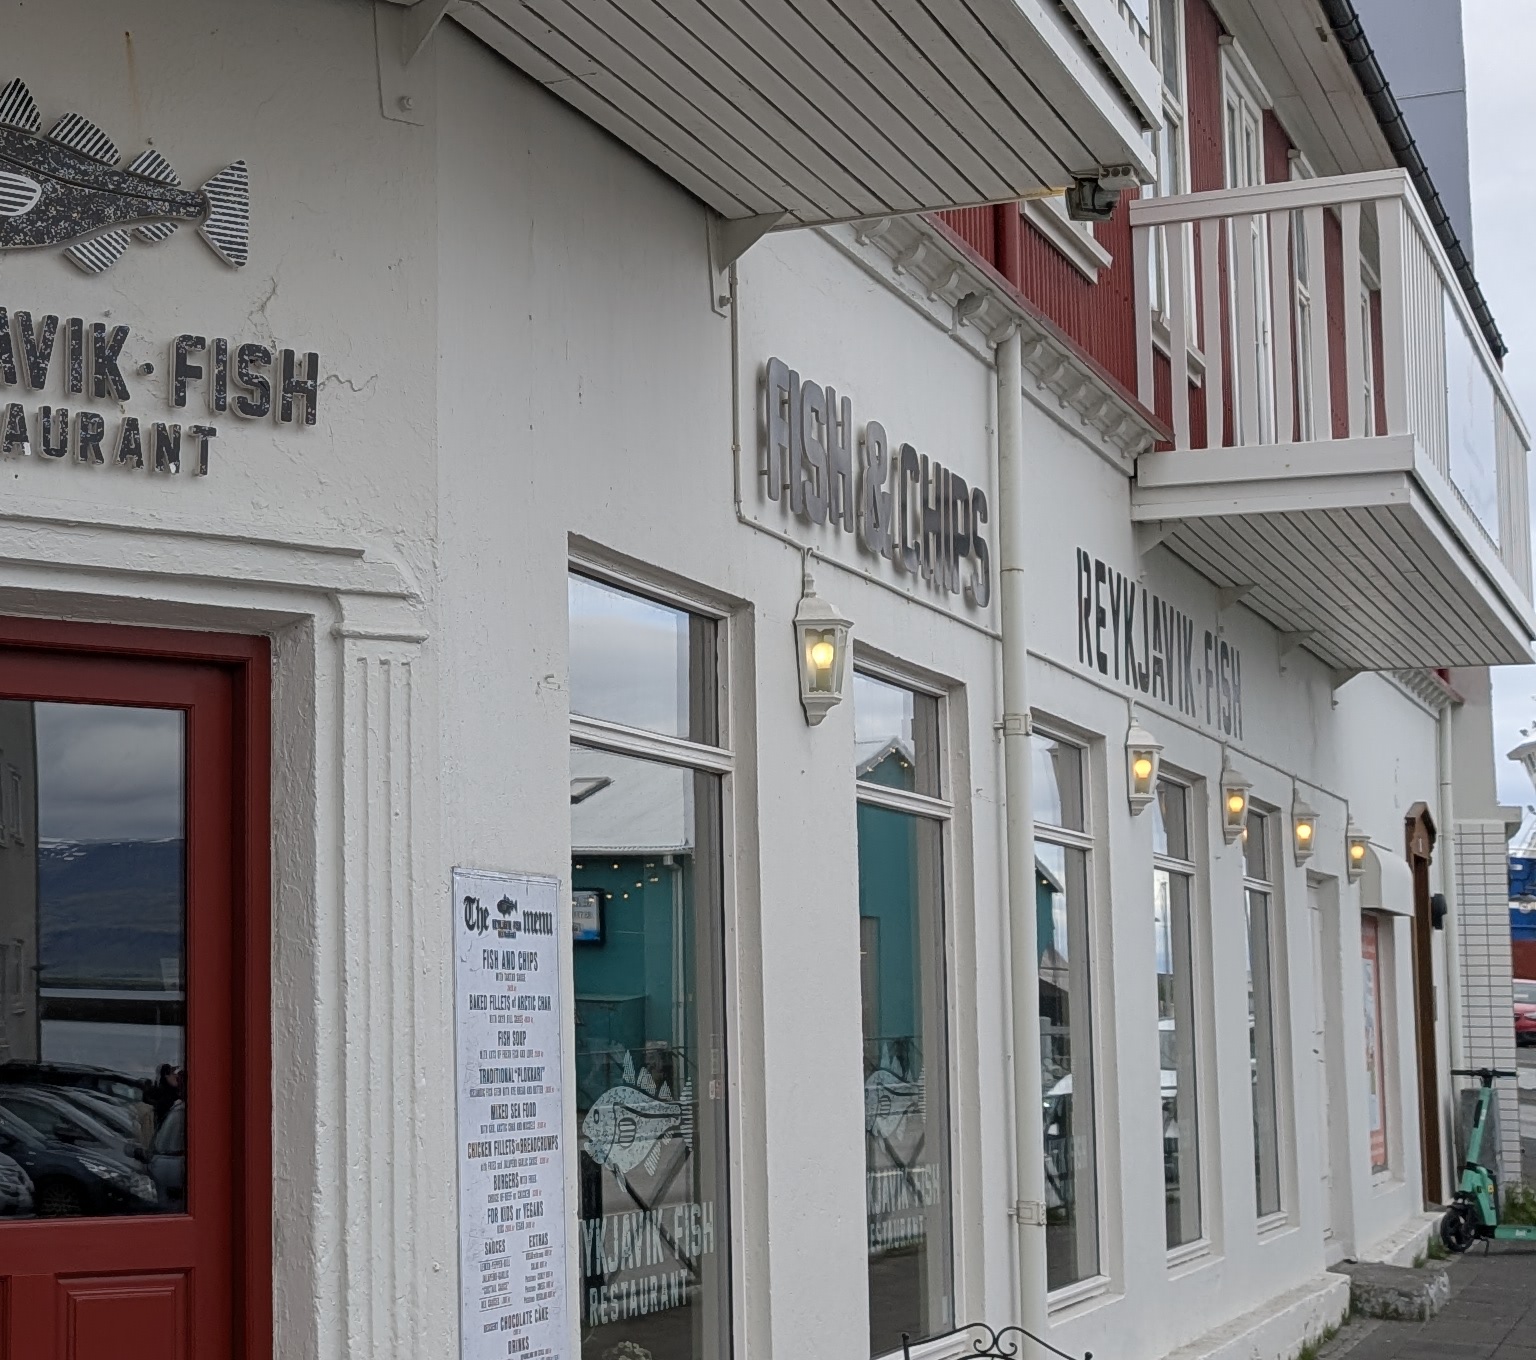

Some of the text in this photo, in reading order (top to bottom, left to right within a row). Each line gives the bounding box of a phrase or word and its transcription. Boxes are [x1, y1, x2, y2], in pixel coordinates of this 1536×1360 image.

[168, 334, 319, 426] FISH
[766, 357, 990, 609] FISH & CHIPS
[1076, 546, 1244, 741] REYKJAVIK FISH
[463, 896, 490, 936] The
[523, 910, 553, 936] menu
[483, 949, 538, 971] FISH AND CHIPS
[494, 1172, 519, 1191] BURGERS
[675, 1201, 714, 1259] FISH
[589, 1268, 687, 1327] RESTAURANT
